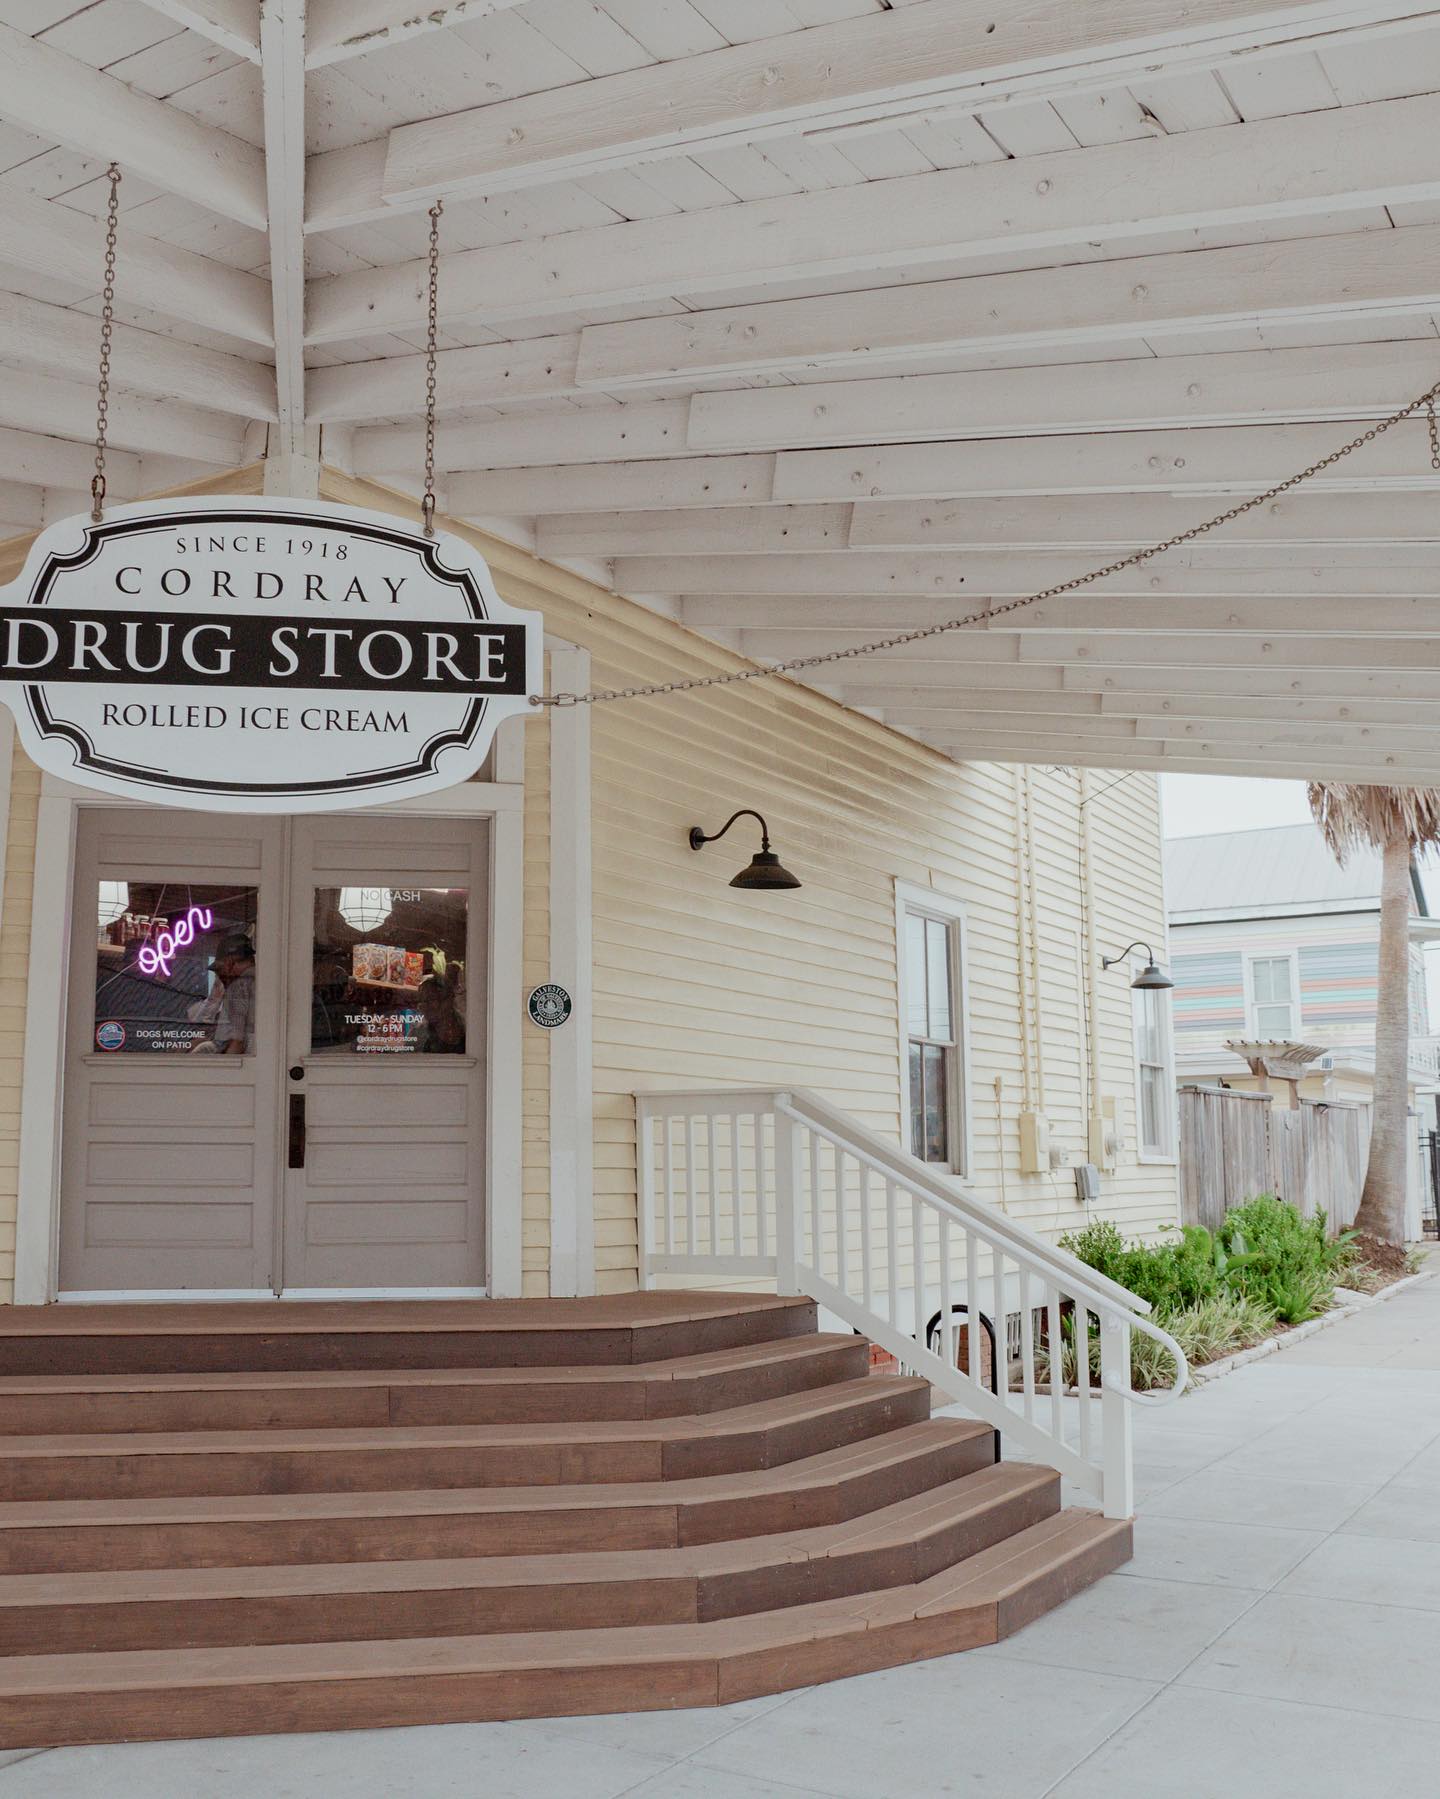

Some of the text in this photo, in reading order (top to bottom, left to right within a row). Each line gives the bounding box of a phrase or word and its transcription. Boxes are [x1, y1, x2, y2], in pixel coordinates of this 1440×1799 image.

[176, 536, 349, 561] SINCE 1918
[115, 565, 408, 604] CORDRAY
[1, 618, 507, 683] DRUG STORE
[102, 703, 411, 734] ROLLED ICE CREAM
[361, 890, 421, 902] NO CASH
[138, 907, 213, 977] open
[532, 985, 569, 1002] GALVESTON
[344, 1014, 384, 1024] TUESDAY
[390, 1015, 424, 1024] SUNDAY
[136, 1030, 206, 1039] DOGS WELCOME
[367, 1024, 376, 1033] 12
[382, 1024, 388, 1033] 6
[389, 1024, 403, 1033] PM
[151, 1041, 192, 1049] ON PATIO
